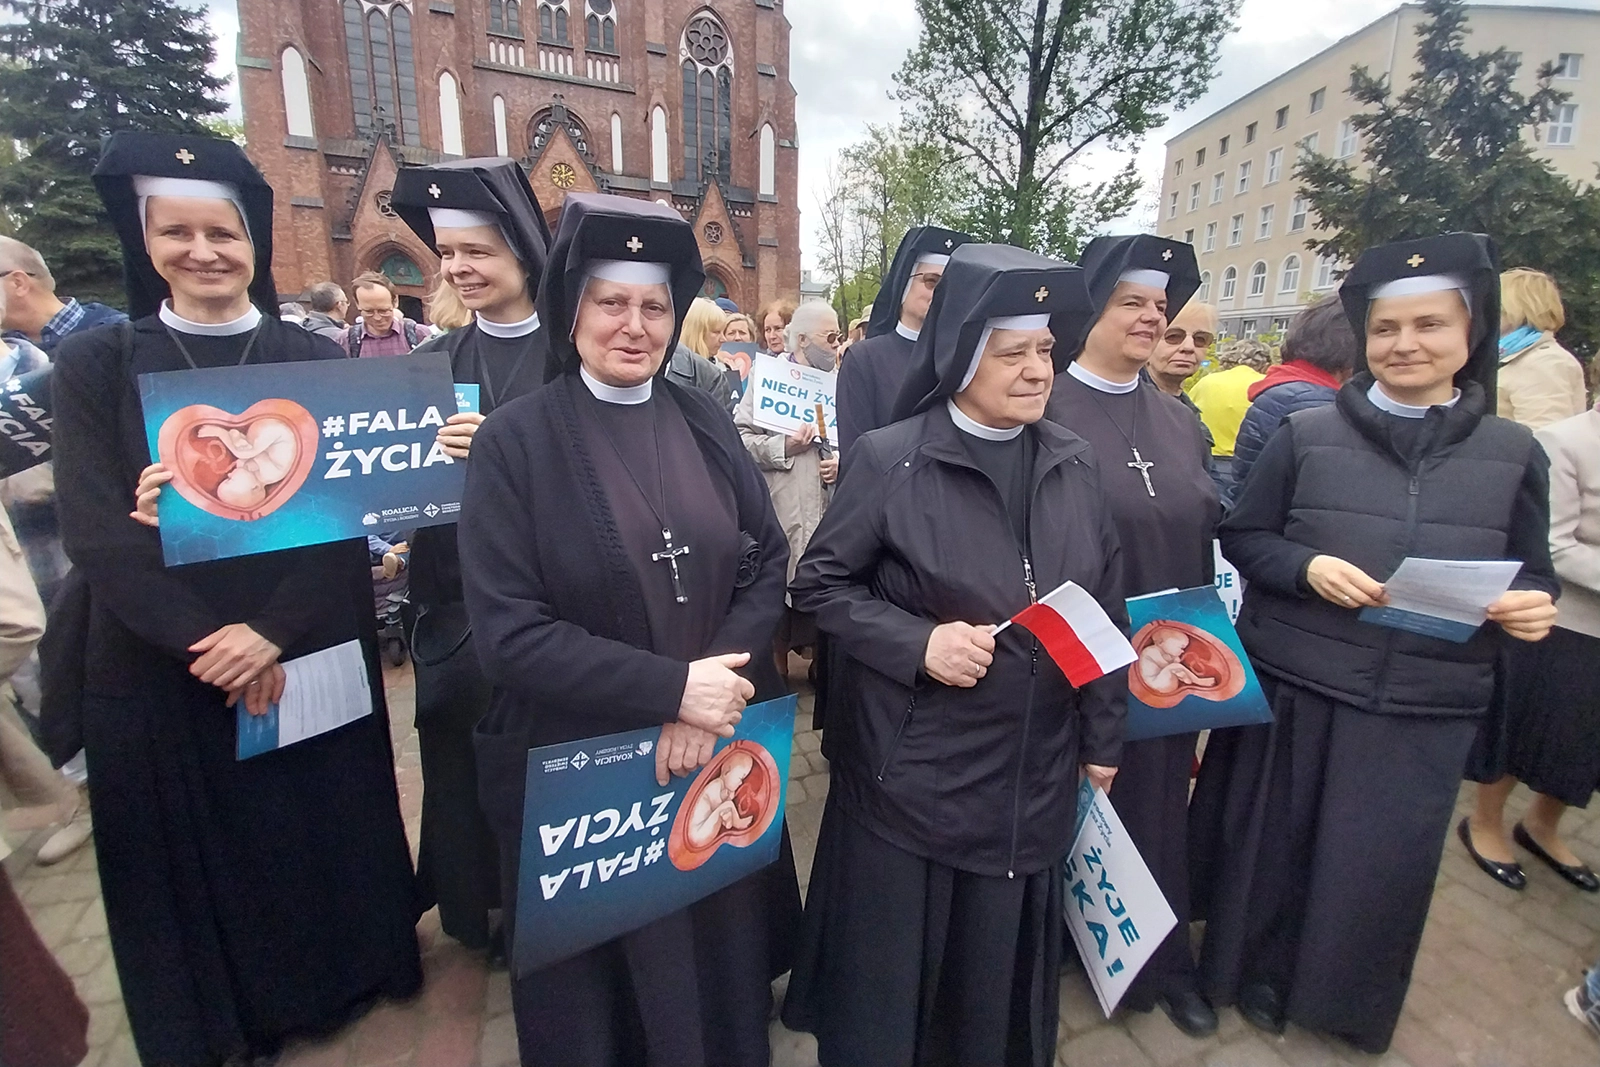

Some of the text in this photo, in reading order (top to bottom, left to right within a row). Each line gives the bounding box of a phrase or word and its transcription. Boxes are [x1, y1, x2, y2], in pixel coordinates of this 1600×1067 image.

[6, 378, 54, 431] #FAL
[761, 377, 809, 400] NIECH
[322, 405, 444, 438] #FALA
[323, 441, 454, 479] ŻYCIA
[381, 505, 419, 516] KOALICJA
[594, 752, 633, 766] KOALICJA
[539, 791, 675, 857] ŻYCIA
[539, 837, 666, 901] #FALA
[1082, 845, 1140, 947] ŻYJE
